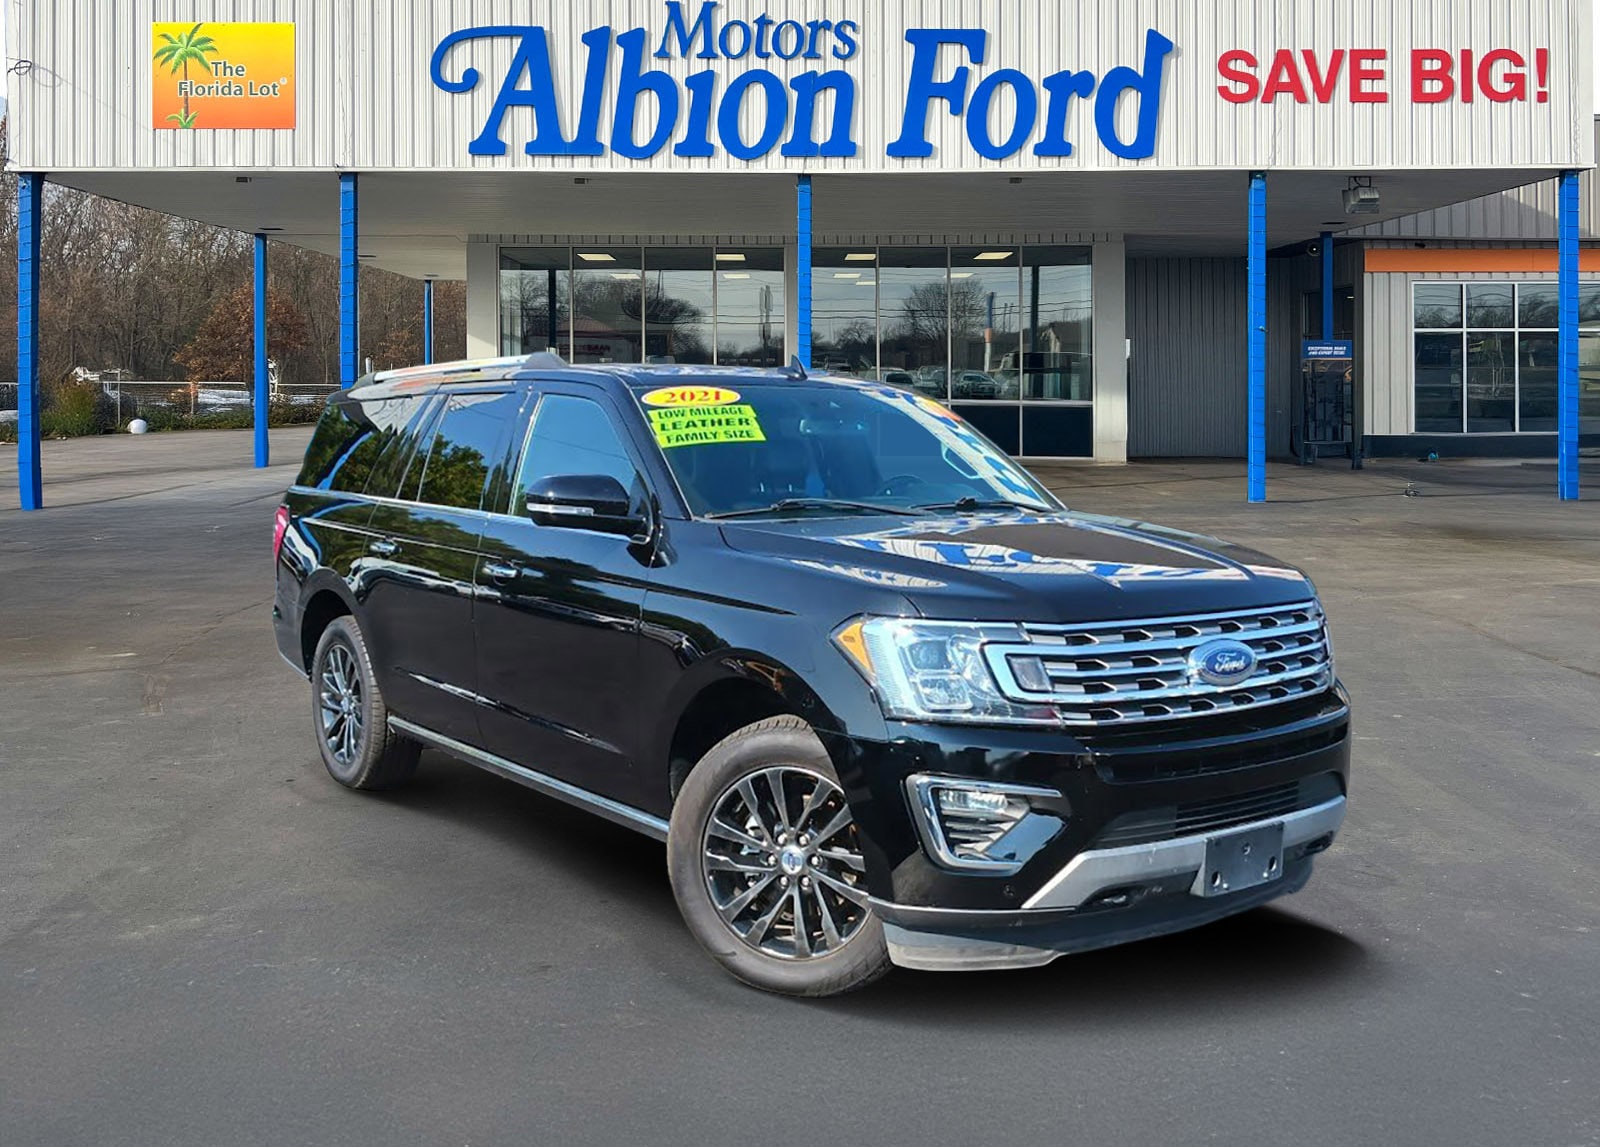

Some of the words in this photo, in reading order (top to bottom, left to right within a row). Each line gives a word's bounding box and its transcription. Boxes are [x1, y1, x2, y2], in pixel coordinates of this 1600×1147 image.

[654, 1, 857, 60] Motors
[211, 61, 245, 77] The
[1217, 48, 1388, 103] SAVE
[1412, 48, 1549, 103] BIG!
[178, 81, 243, 97] Florida
[430, 26, 857, 160] Albion
[886, 28, 1176, 160] Ford
[663, 390, 721, 403] 2021
[658, 410, 686, 419] LOW
[689, 406, 744, 417] MILEAGE
[660, 418, 750, 431] LEATHER
[666, 431, 718, 444] FAMILY
[724, 430, 755, 439] SIZE
[1214, 651, 1246, 673] Ford
